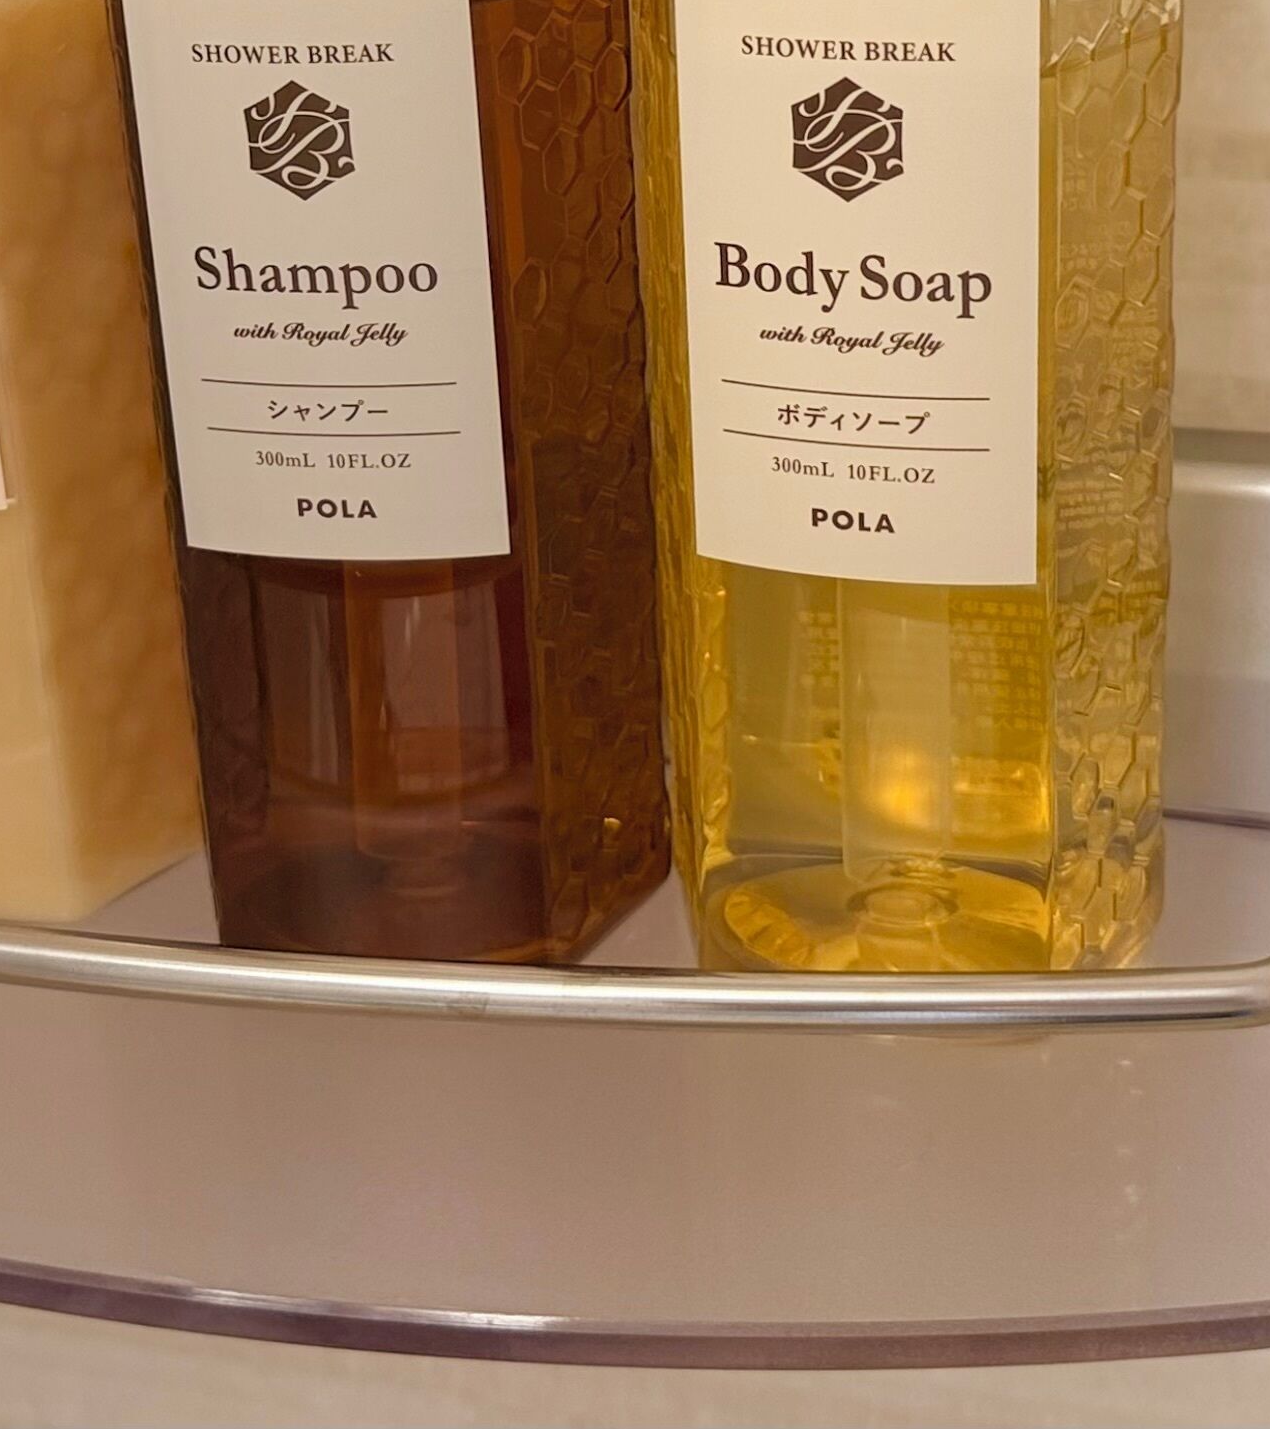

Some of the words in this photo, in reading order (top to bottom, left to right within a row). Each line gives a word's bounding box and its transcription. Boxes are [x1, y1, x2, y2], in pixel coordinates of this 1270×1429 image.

[191, 44, 301, 64] SHOWER
[306, 43, 394, 64] BREAK
[741, 35, 857, 61] SHOWER
[864, 41, 956, 62] BREAK
[194, 246, 438, 310] Shampoo
[714, 242, 850, 313] Body
[860, 254, 992, 319] Soap
[234, 322, 279, 339] with
[282, 322, 350, 347] Royal
[349, 322, 408, 347] Jelly
[759, 325, 808, 343] with
[810, 326, 882, 354] Royal
[880, 330, 945, 357] Jelly
[267, 399, 388, 422] シャンプー
[778, 404, 930, 435] ボディソープ
[256, 450, 316, 468] 300mL
[327, 453, 411, 469] 10FL.OZ
[771, 456, 834, 478] 300mL
[845, 461, 935, 484] 10FL.OZ
[297, 498, 378, 518] POLA
[811, 507, 895, 534] POLA
